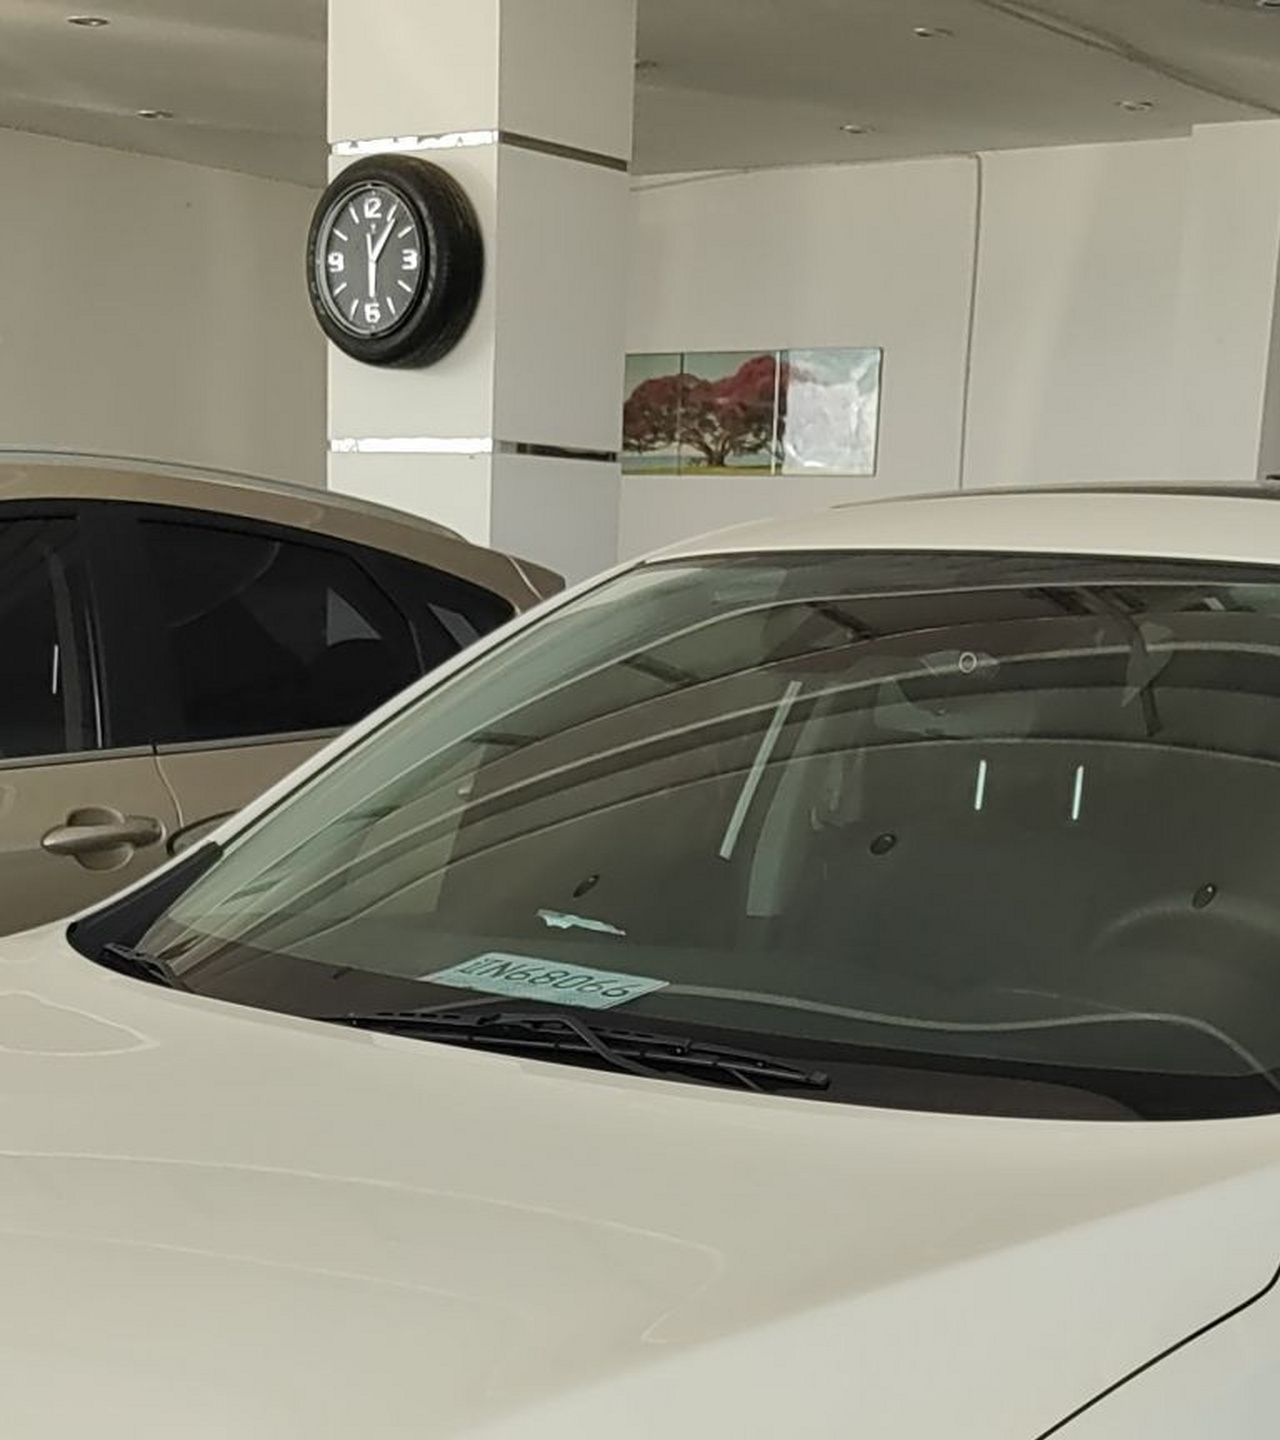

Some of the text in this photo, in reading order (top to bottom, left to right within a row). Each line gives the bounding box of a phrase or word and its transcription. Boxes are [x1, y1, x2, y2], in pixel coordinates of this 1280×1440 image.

[363, 198, 382, 218] 12
[328, 252, 345, 272] 9
[401, 249, 418, 270] 3
[364, 303, 381, 323] 6
